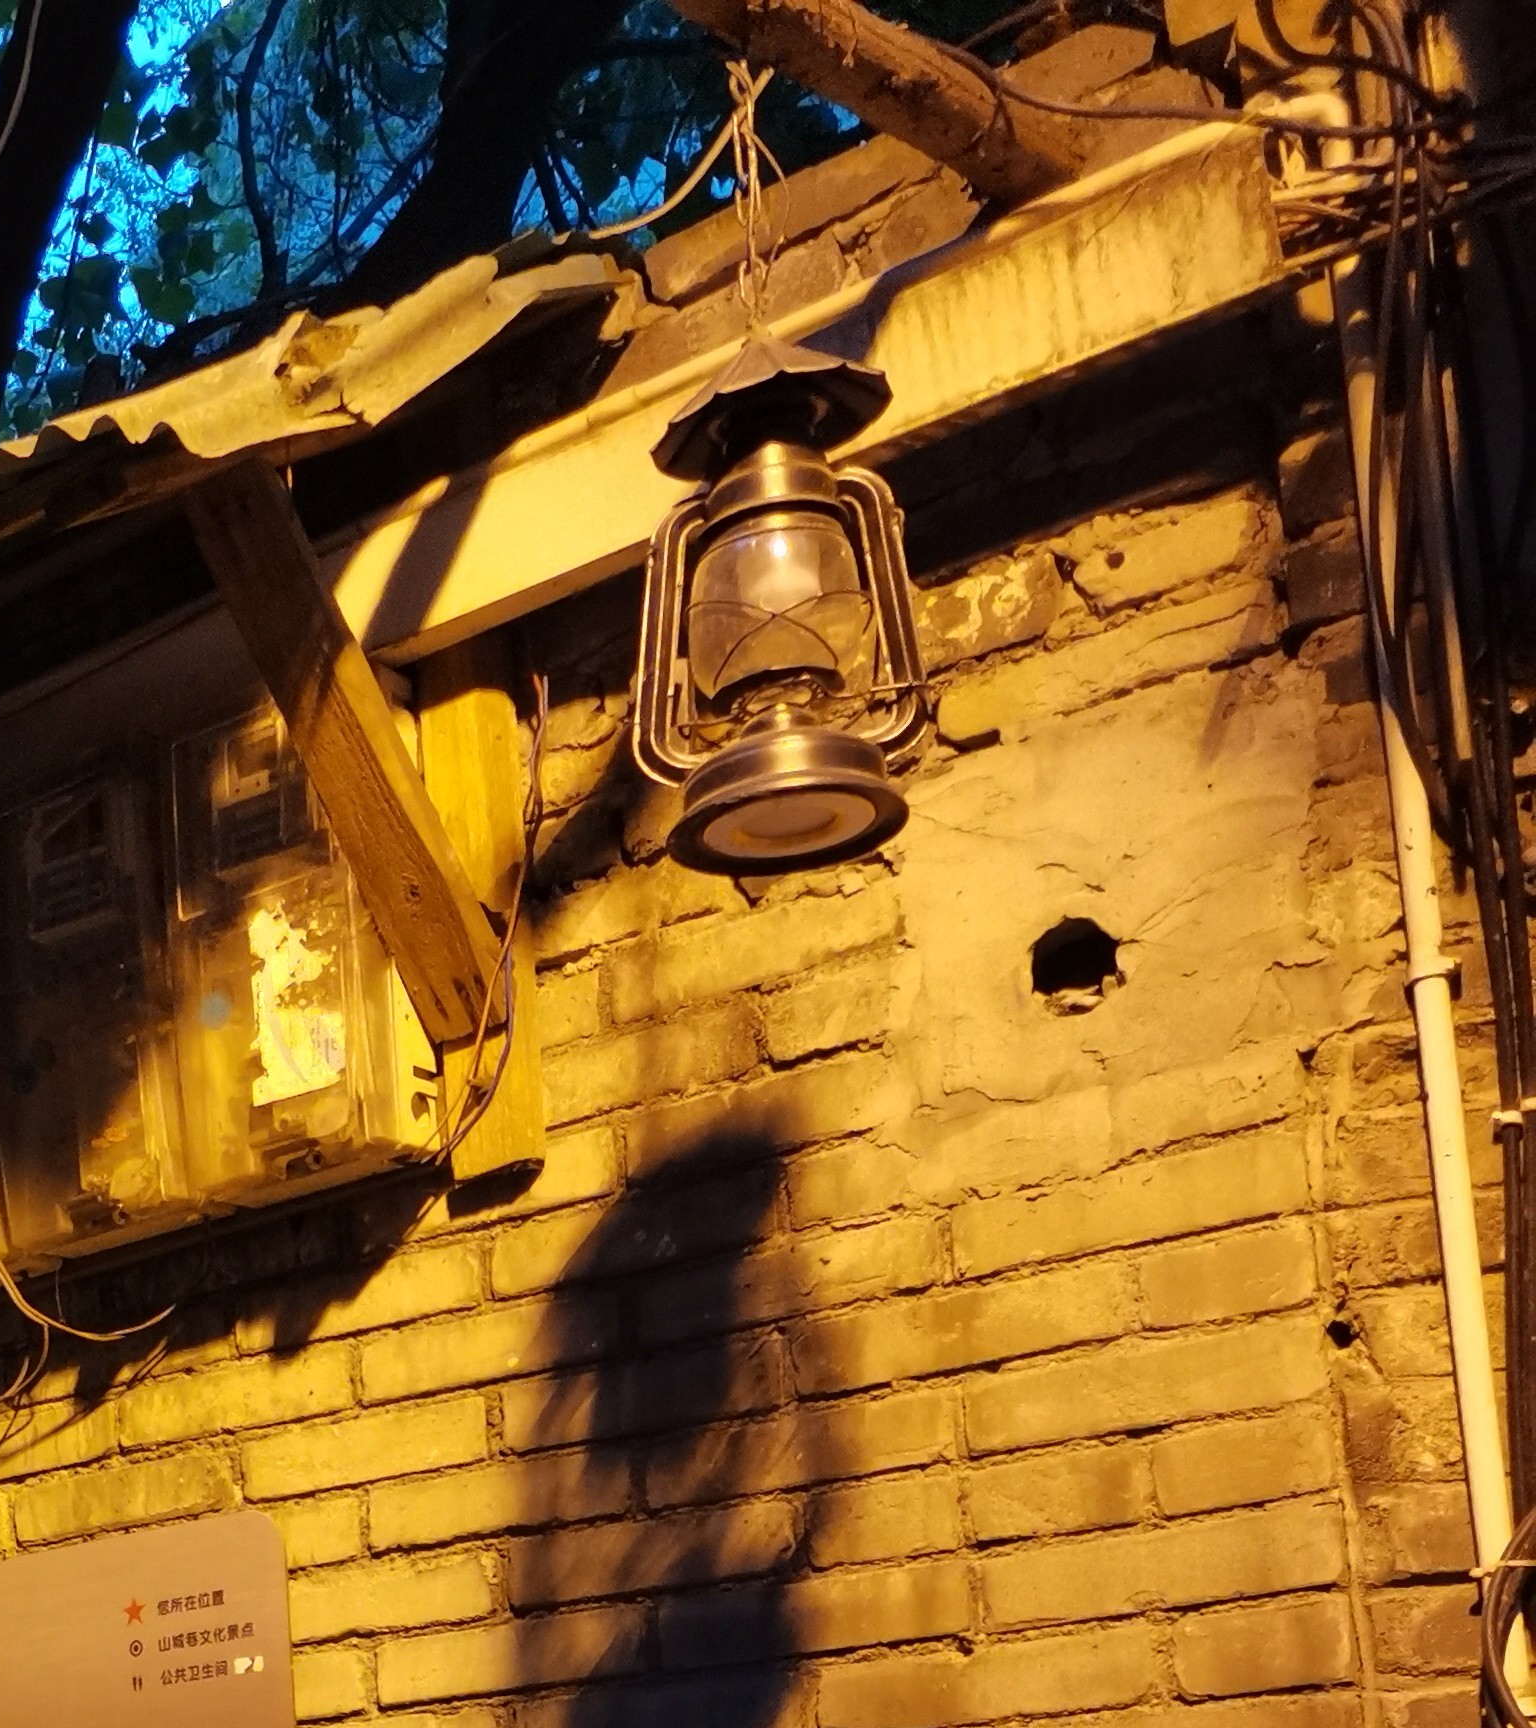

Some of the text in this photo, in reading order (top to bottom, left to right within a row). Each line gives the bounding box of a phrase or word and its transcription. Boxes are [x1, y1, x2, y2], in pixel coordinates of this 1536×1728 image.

[157, 1590, 225, 1616] 您所在位置
[157, 1622, 255, 1652] 山城巷文化景点
[160, 1660, 228, 1685] 公共卫生间
